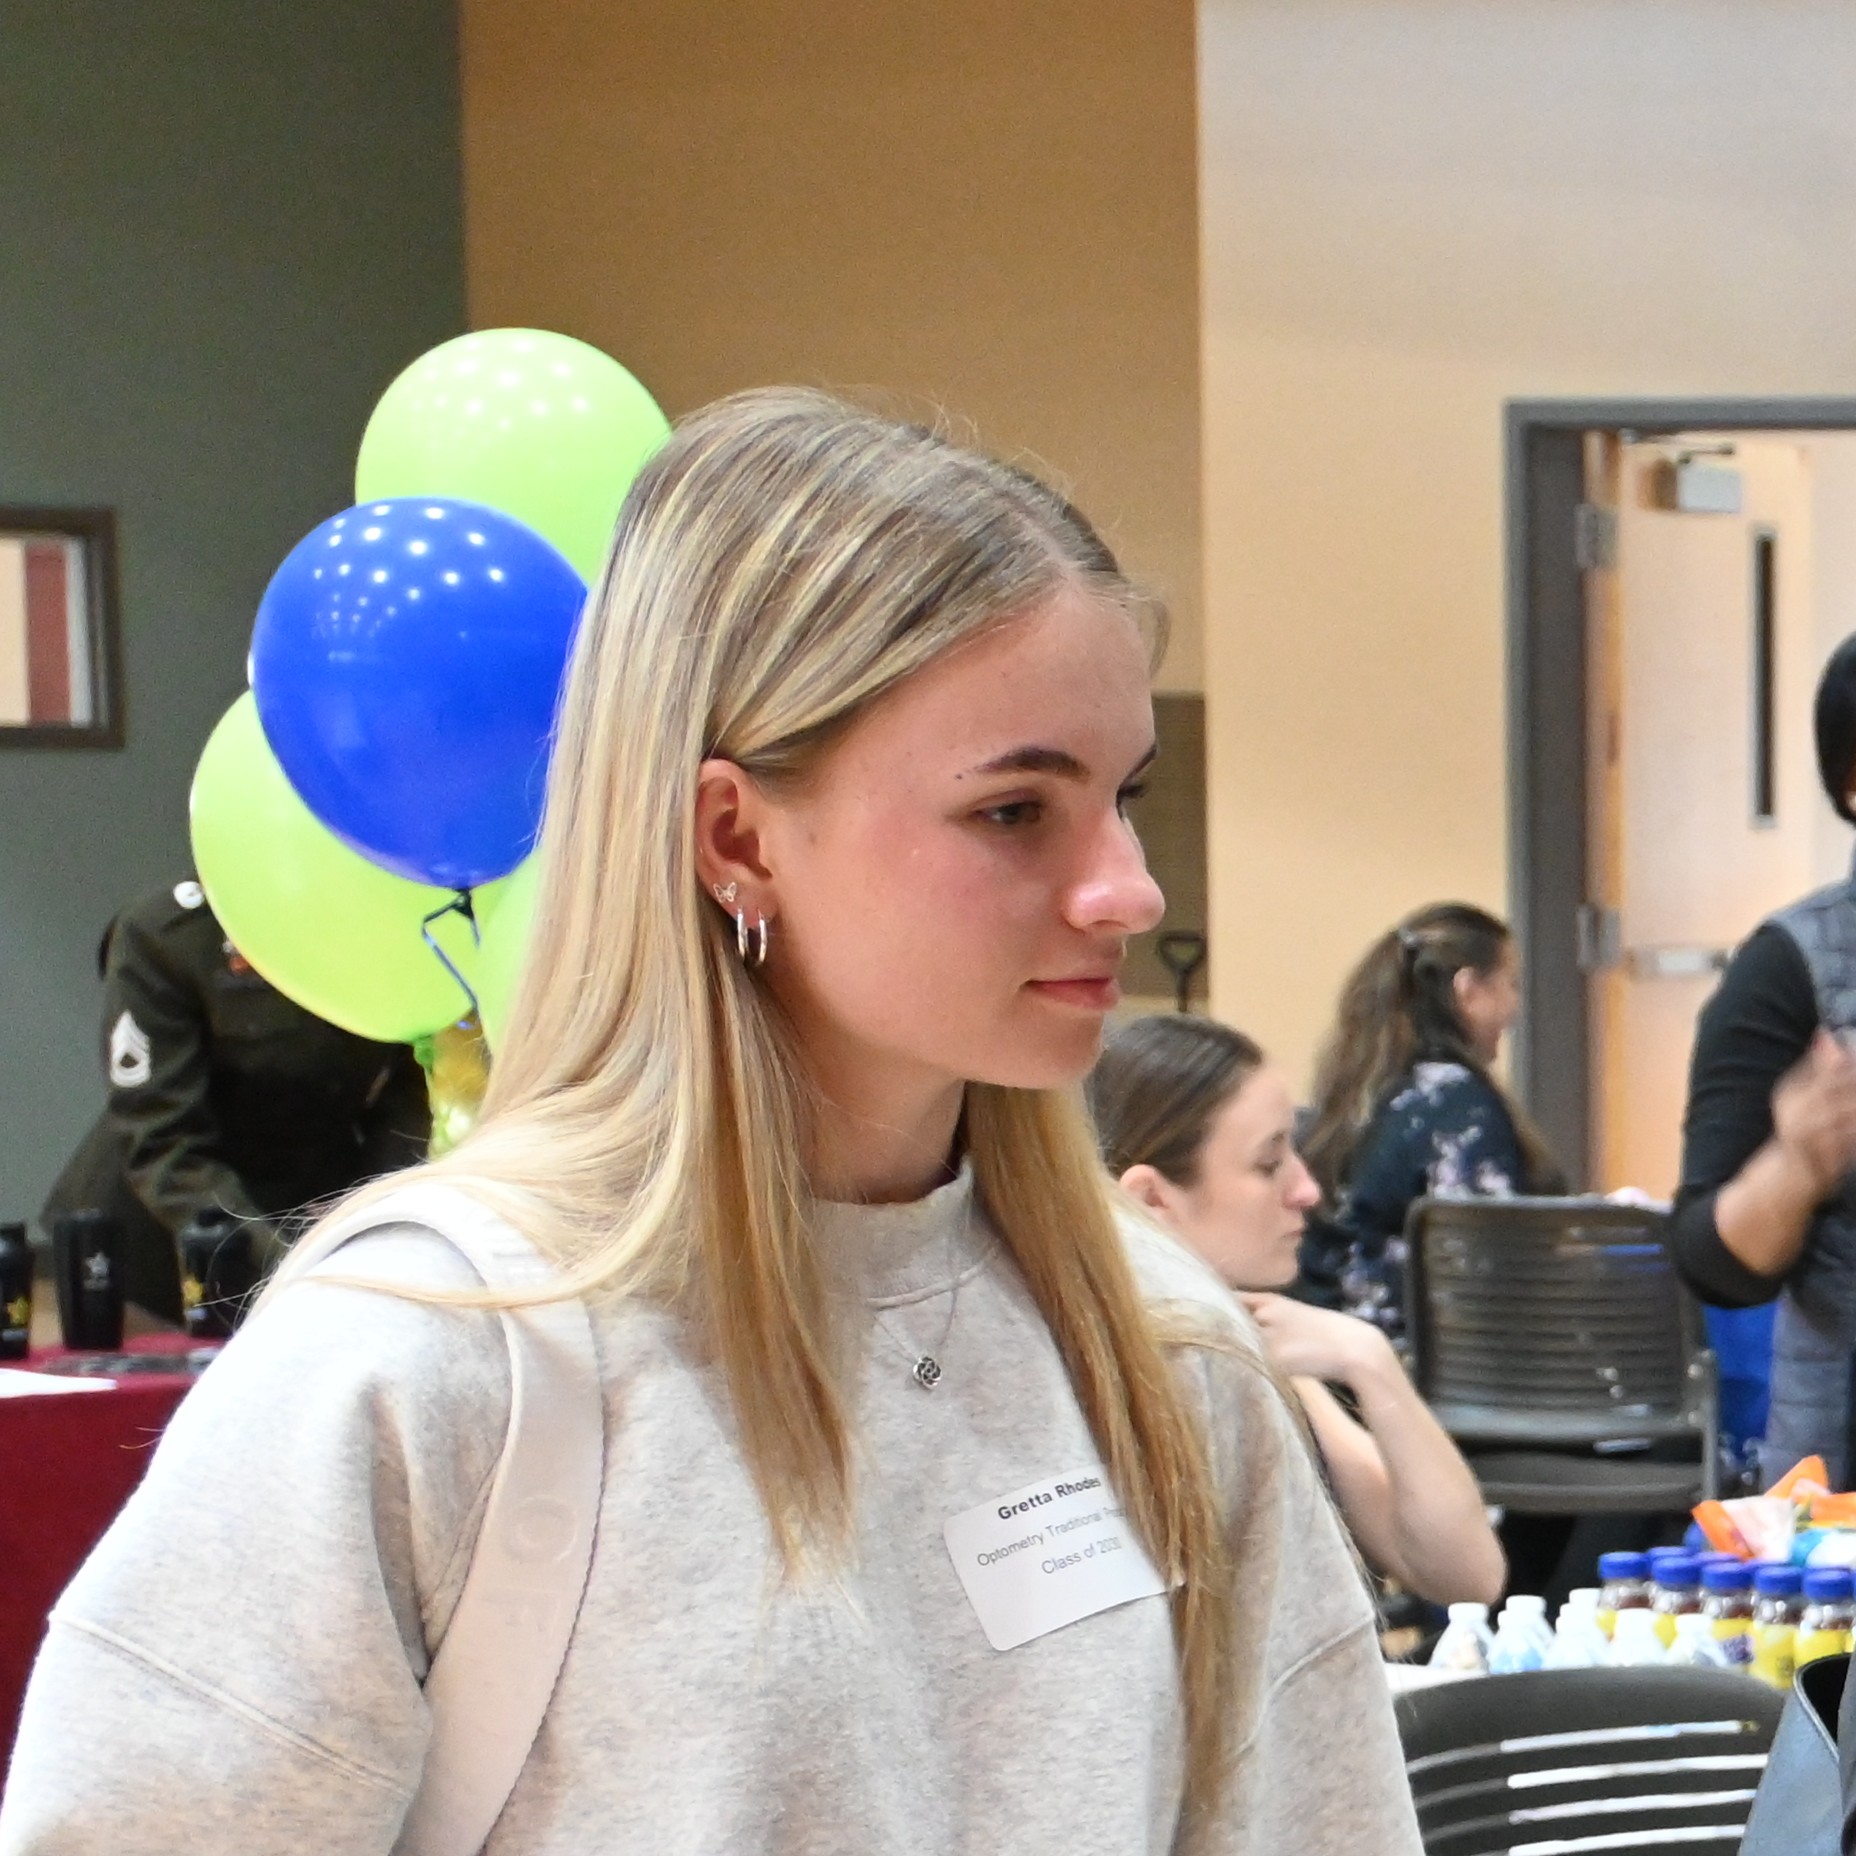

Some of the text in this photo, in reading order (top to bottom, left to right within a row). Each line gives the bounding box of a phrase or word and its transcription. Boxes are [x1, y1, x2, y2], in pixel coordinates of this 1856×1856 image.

[998, 1476, 1101, 1520] Gretta Rhodes
[976, 1508, 1102, 1567] Optometry Traditional
[1041, 1552, 1082, 1575] Class
[1083, 1542, 1096, 1559] of
